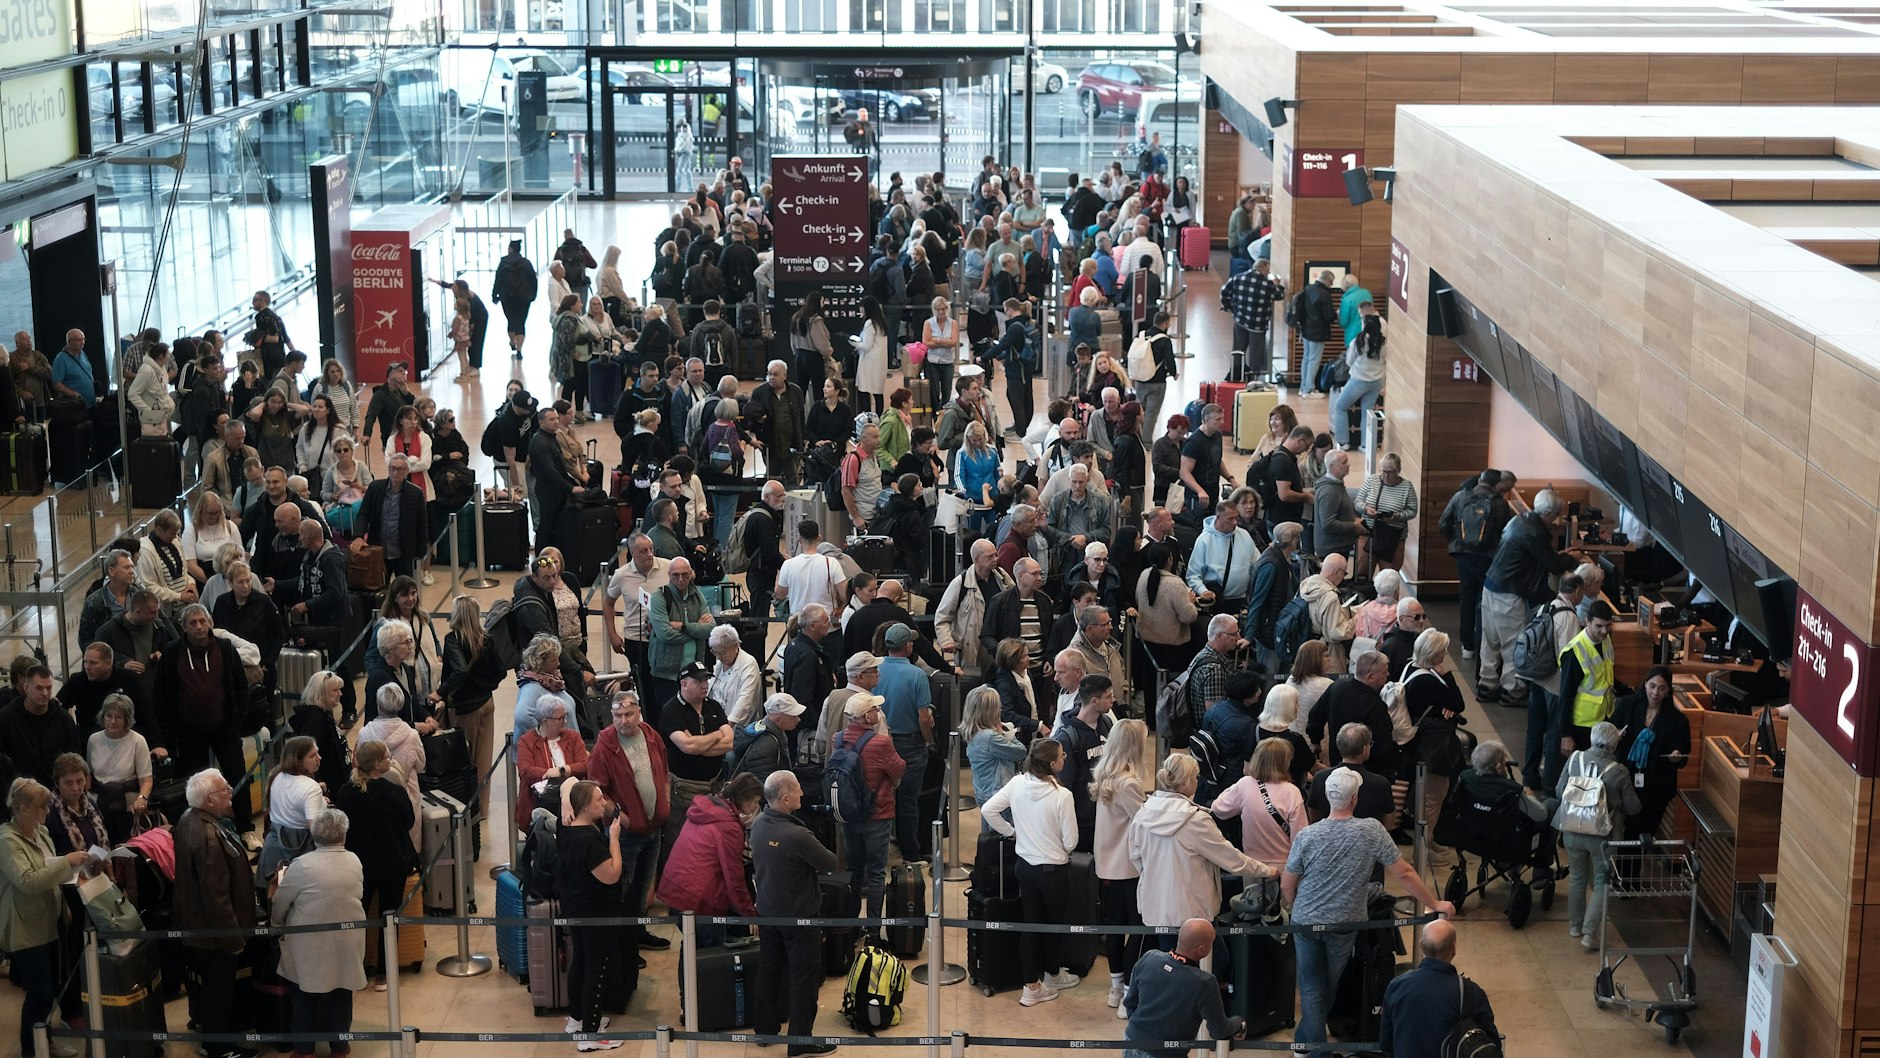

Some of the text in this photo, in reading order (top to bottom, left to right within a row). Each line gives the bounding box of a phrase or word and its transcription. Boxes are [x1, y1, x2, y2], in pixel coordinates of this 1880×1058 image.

[58, 87, 66, 118] 0
[1302, 152, 1333, 161] Check-in
[803, 164, 846, 173] Ankunft
[796, 195, 839, 204] Check-in
[796, 206, 803, 215] 0
[802, 224, 846, 234] Check-in
[353, 268, 403, 277] GOODBYE
[1401, 253, 1408, 300] 2
[353, 278, 404, 288] BERLIN
[375, 338, 387, 347] Fly
[1800, 603, 1832, 649] Check-in
[1798, 636, 1827, 679] 211–216
[1837, 643, 1859, 740] 2
